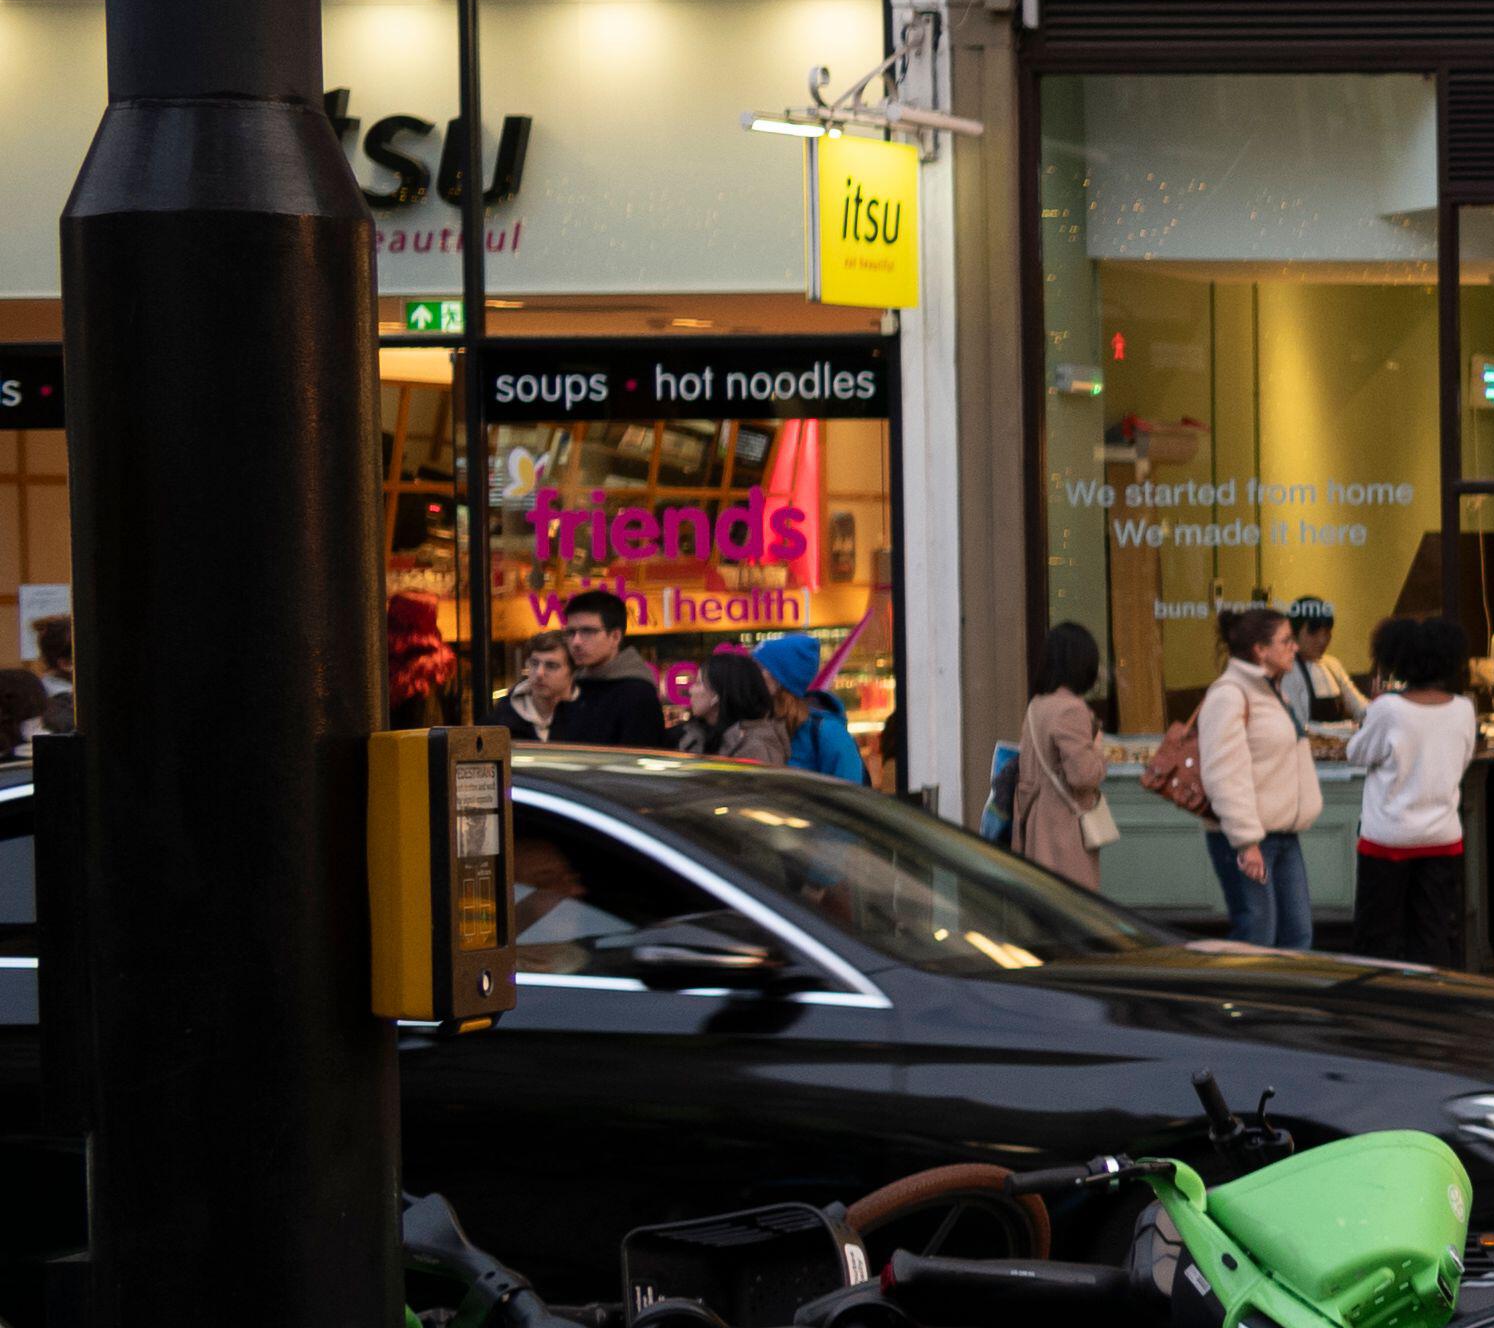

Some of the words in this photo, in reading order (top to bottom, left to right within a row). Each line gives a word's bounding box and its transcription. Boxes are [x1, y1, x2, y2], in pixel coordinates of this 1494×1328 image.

[842, 177, 901, 244] itsu
[496, 373, 609, 411] soups
[655, 363, 714, 402] hot
[727, 361, 876, 400] noodles
[1064, 479, 1116, 508] We
[1124, 479, 1236, 508] started
[1246, 479, 1318, 506] from
[1326, 480, 1414, 506] home
[525, 485, 808, 562] friends
[1113, 519, 1166, 549] We
[1174, 519, 1260, 547] made
[1271, 519, 1290, 547] it
[1299, 522, 1367, 547] here
[1153, 598, 1209, 620] buns
